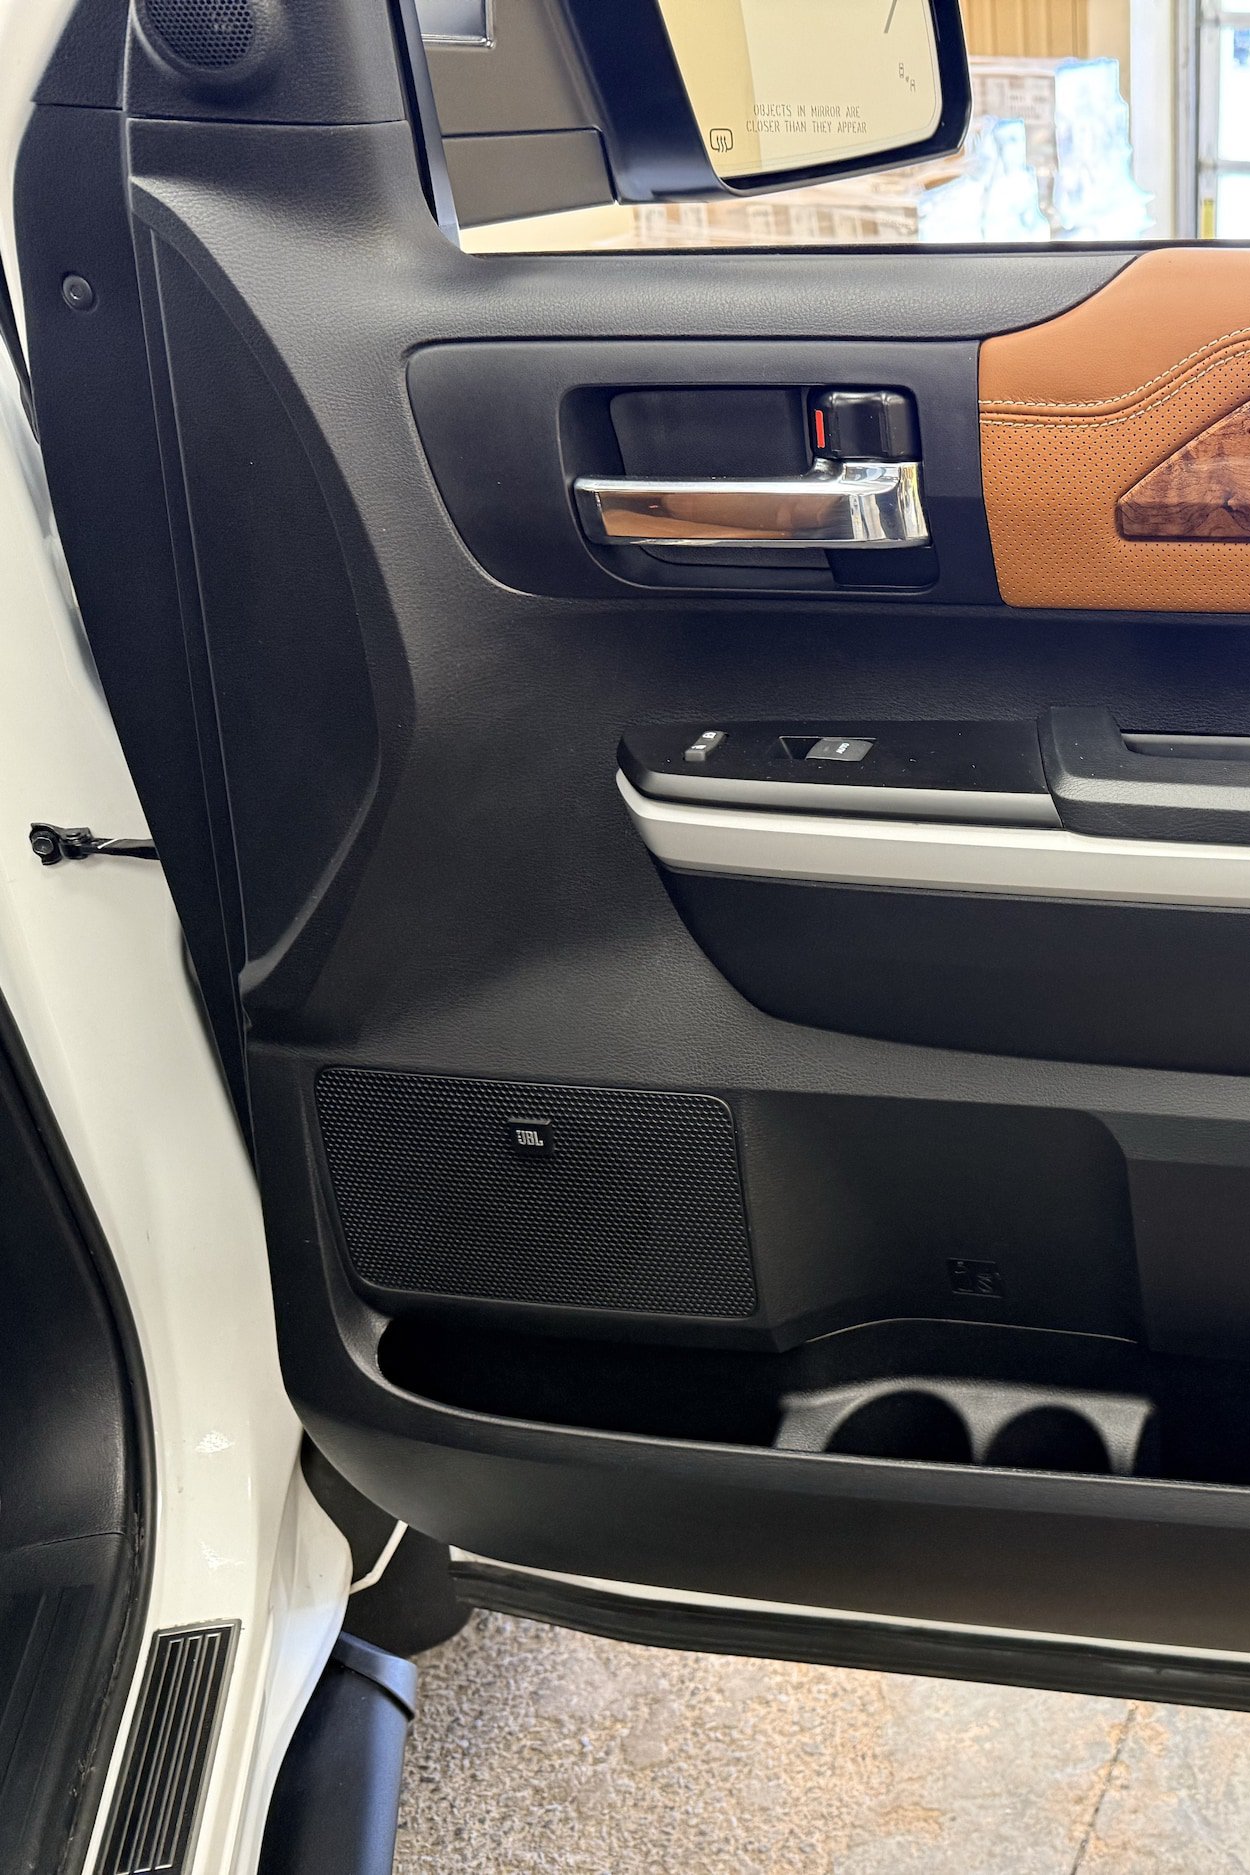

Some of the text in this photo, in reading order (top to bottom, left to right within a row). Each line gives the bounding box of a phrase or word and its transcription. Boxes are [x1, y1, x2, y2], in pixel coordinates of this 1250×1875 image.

[753, 103, 860, 118] OBJECTS IN MIRROR ARE
[746, 119, 867, 134] CLOSER THAN THEY APPEAR
[515, 1129, 544, 1146] JBL
